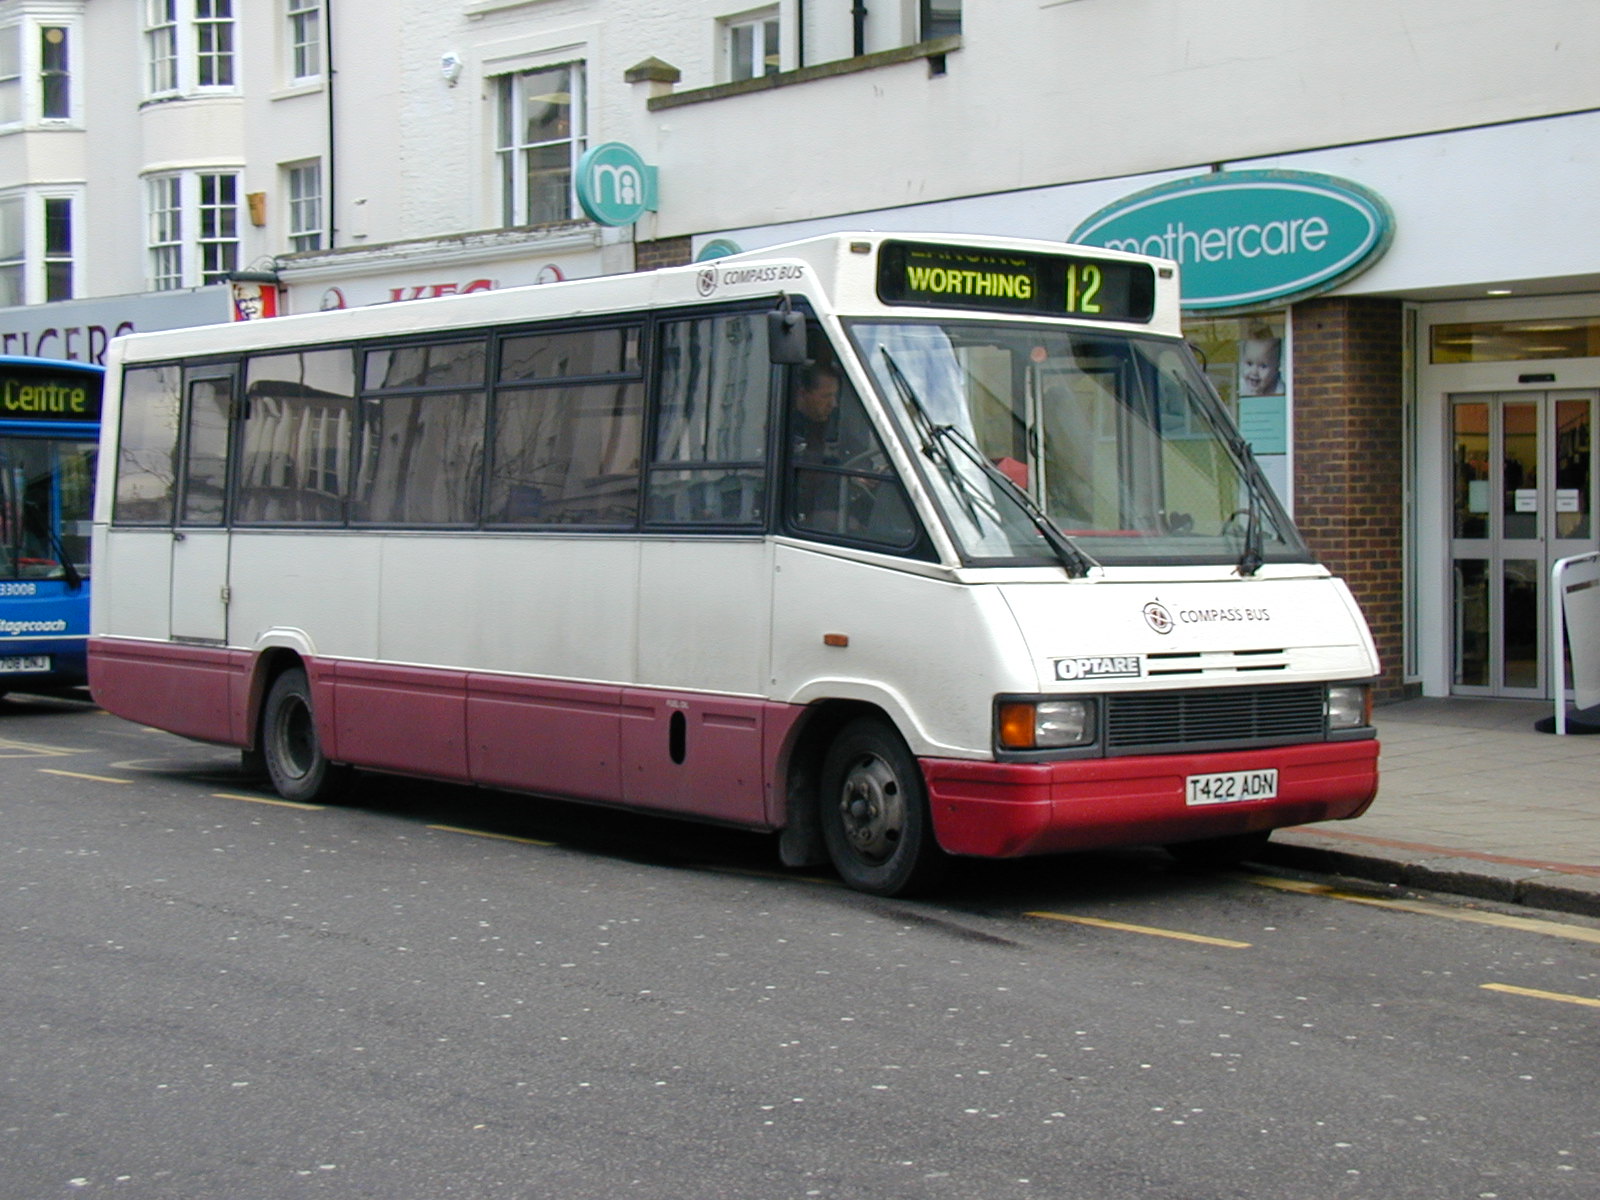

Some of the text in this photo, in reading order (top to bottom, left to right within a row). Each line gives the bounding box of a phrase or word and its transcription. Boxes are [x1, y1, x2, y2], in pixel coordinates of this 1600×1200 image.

[723, 265, 804, 285] COMPASS BUS
[907, 266, 1031, 299] WORTHING
[1066, 264, 1101, 313] 12
[4, 380, 85, 413] Centre
[0, 619, 67, 635] tagecoach
[1180, 608, 1271, 623] COMPASS BUS
[1057, 658, 1139, 679] OPTARE
[1190, 773, 1275, 801] T422 ADN
